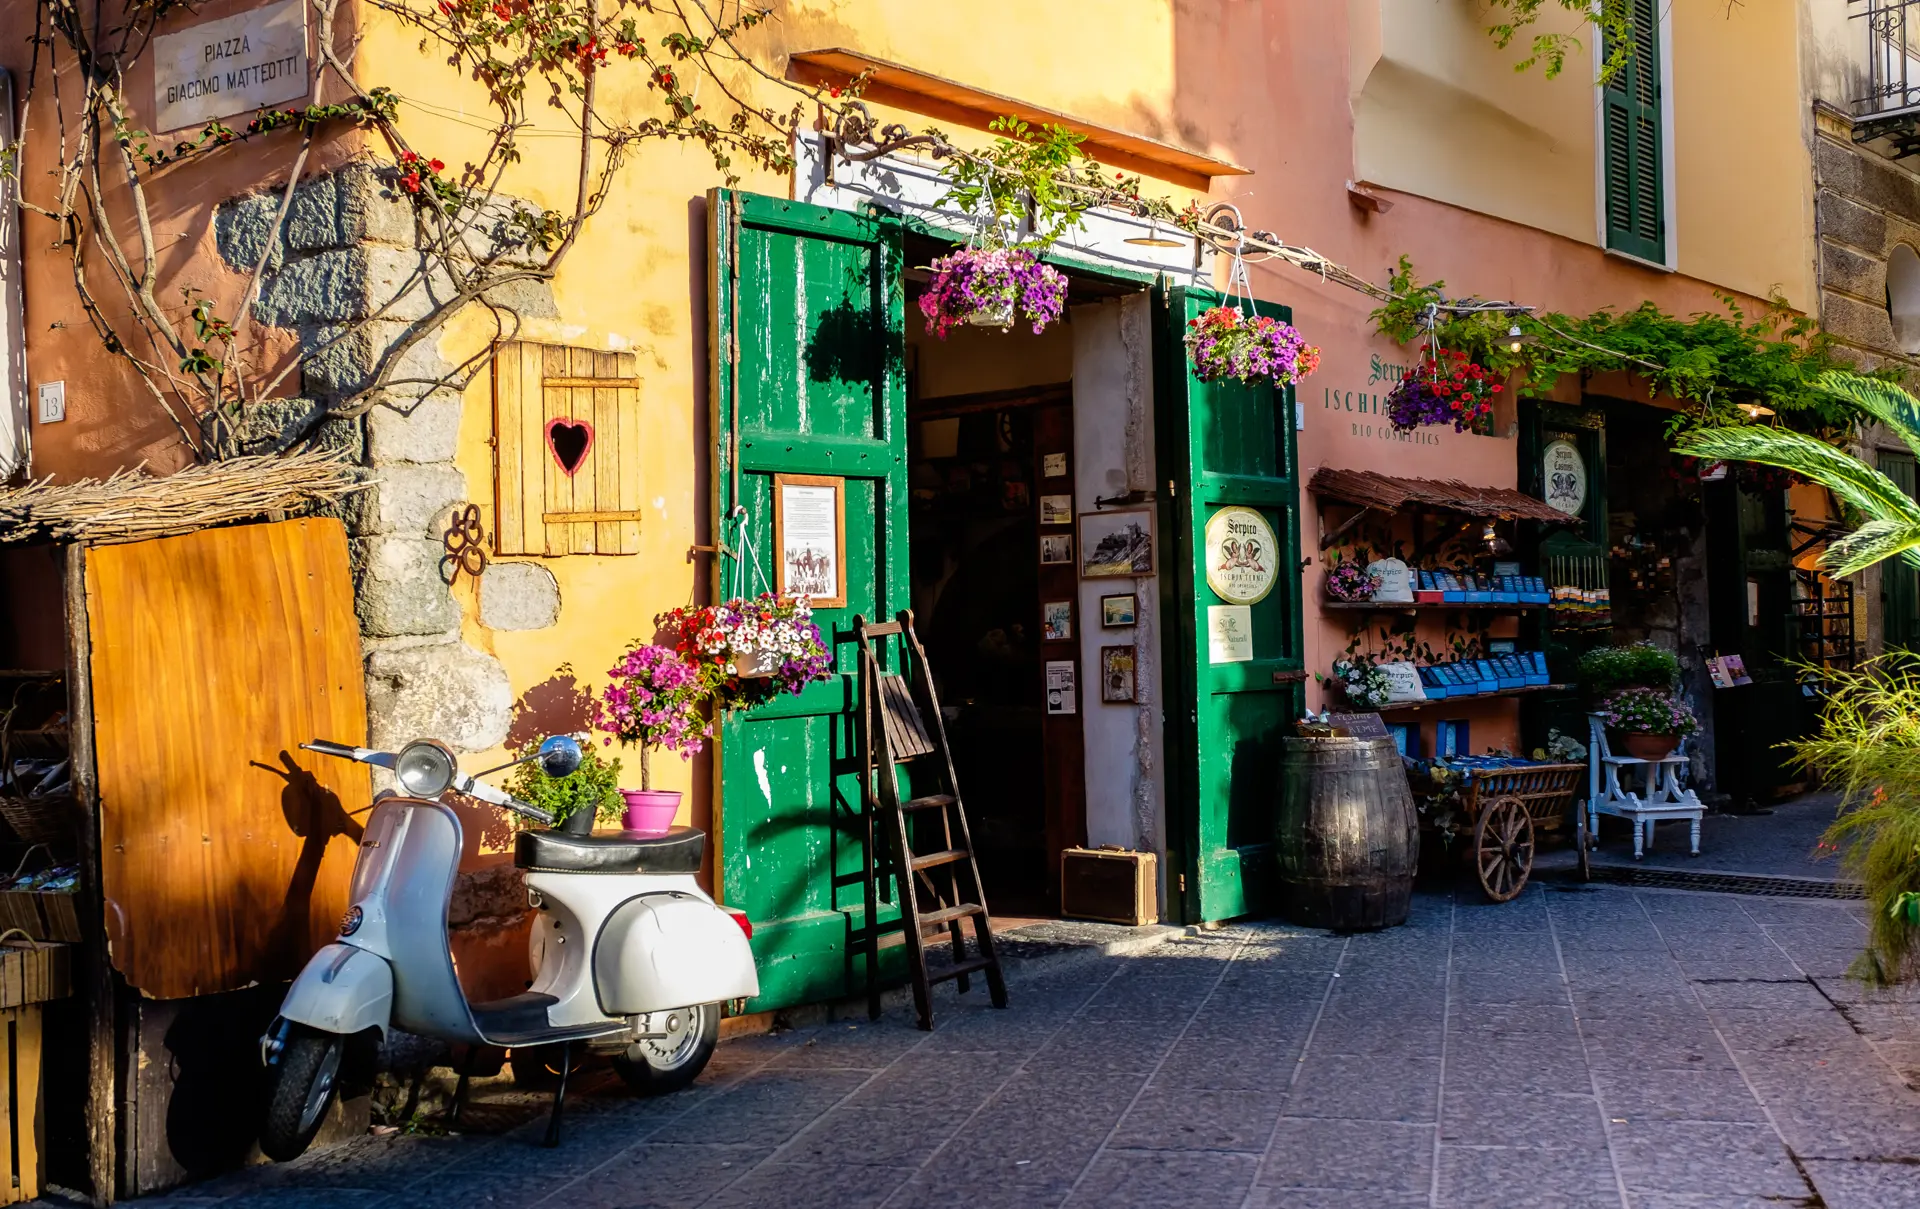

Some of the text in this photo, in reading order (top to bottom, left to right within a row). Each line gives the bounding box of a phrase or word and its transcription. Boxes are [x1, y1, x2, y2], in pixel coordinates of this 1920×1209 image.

[205, 35, 250, 62] PIAZZA
[167, 55, 297, 104] GIACOMO MATTEOTTI
[1368, 353, 1410, 386] Serp
[45, 397, 58, 417] 13
[1324, 387, 1390, 416] ISCHIA
[1352, 423, 1440, 446] BIO COSMETICS
[1226, 518, 1257, 537] Serpico
[1348, 724, 1380, 734] REME
